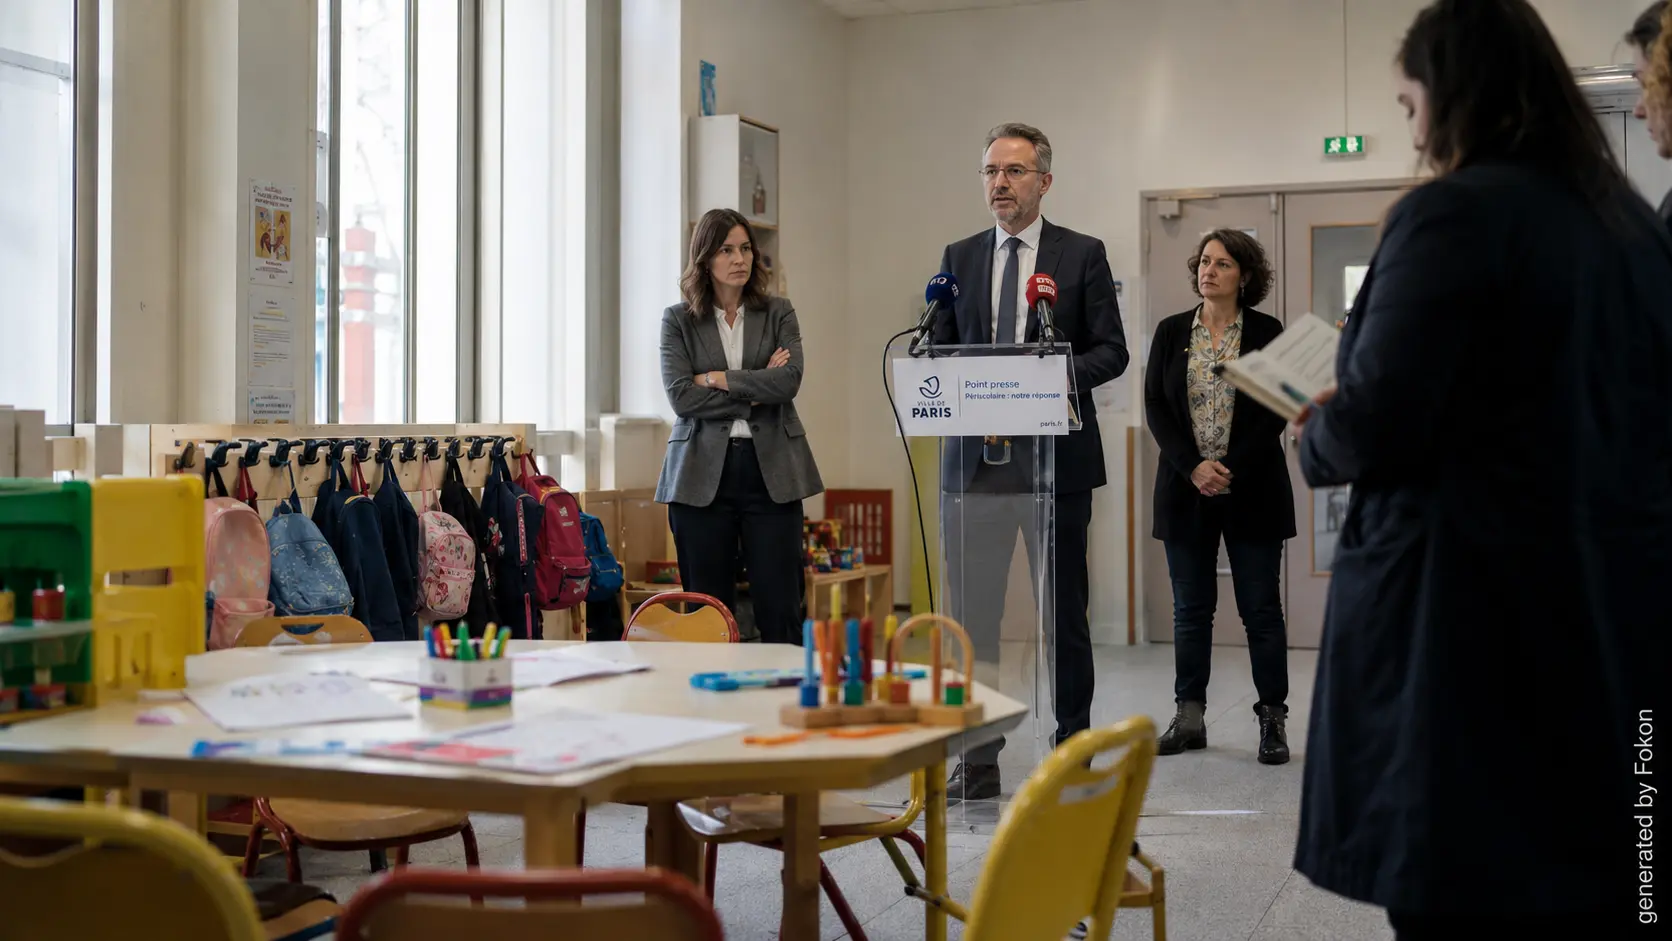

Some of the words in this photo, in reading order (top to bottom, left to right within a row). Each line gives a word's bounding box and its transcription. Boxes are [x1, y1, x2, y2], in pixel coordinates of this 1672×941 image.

[965, 380, 988, 389] Point
[990, 381, 1020, 390] presse
[965, 392, 1006, 400] Périscolaire
[1032, 392, 1060, 400] réponse
[912, 407, 952, 418] PARIS
[1040, 420, 1063, 428] paris.fr
